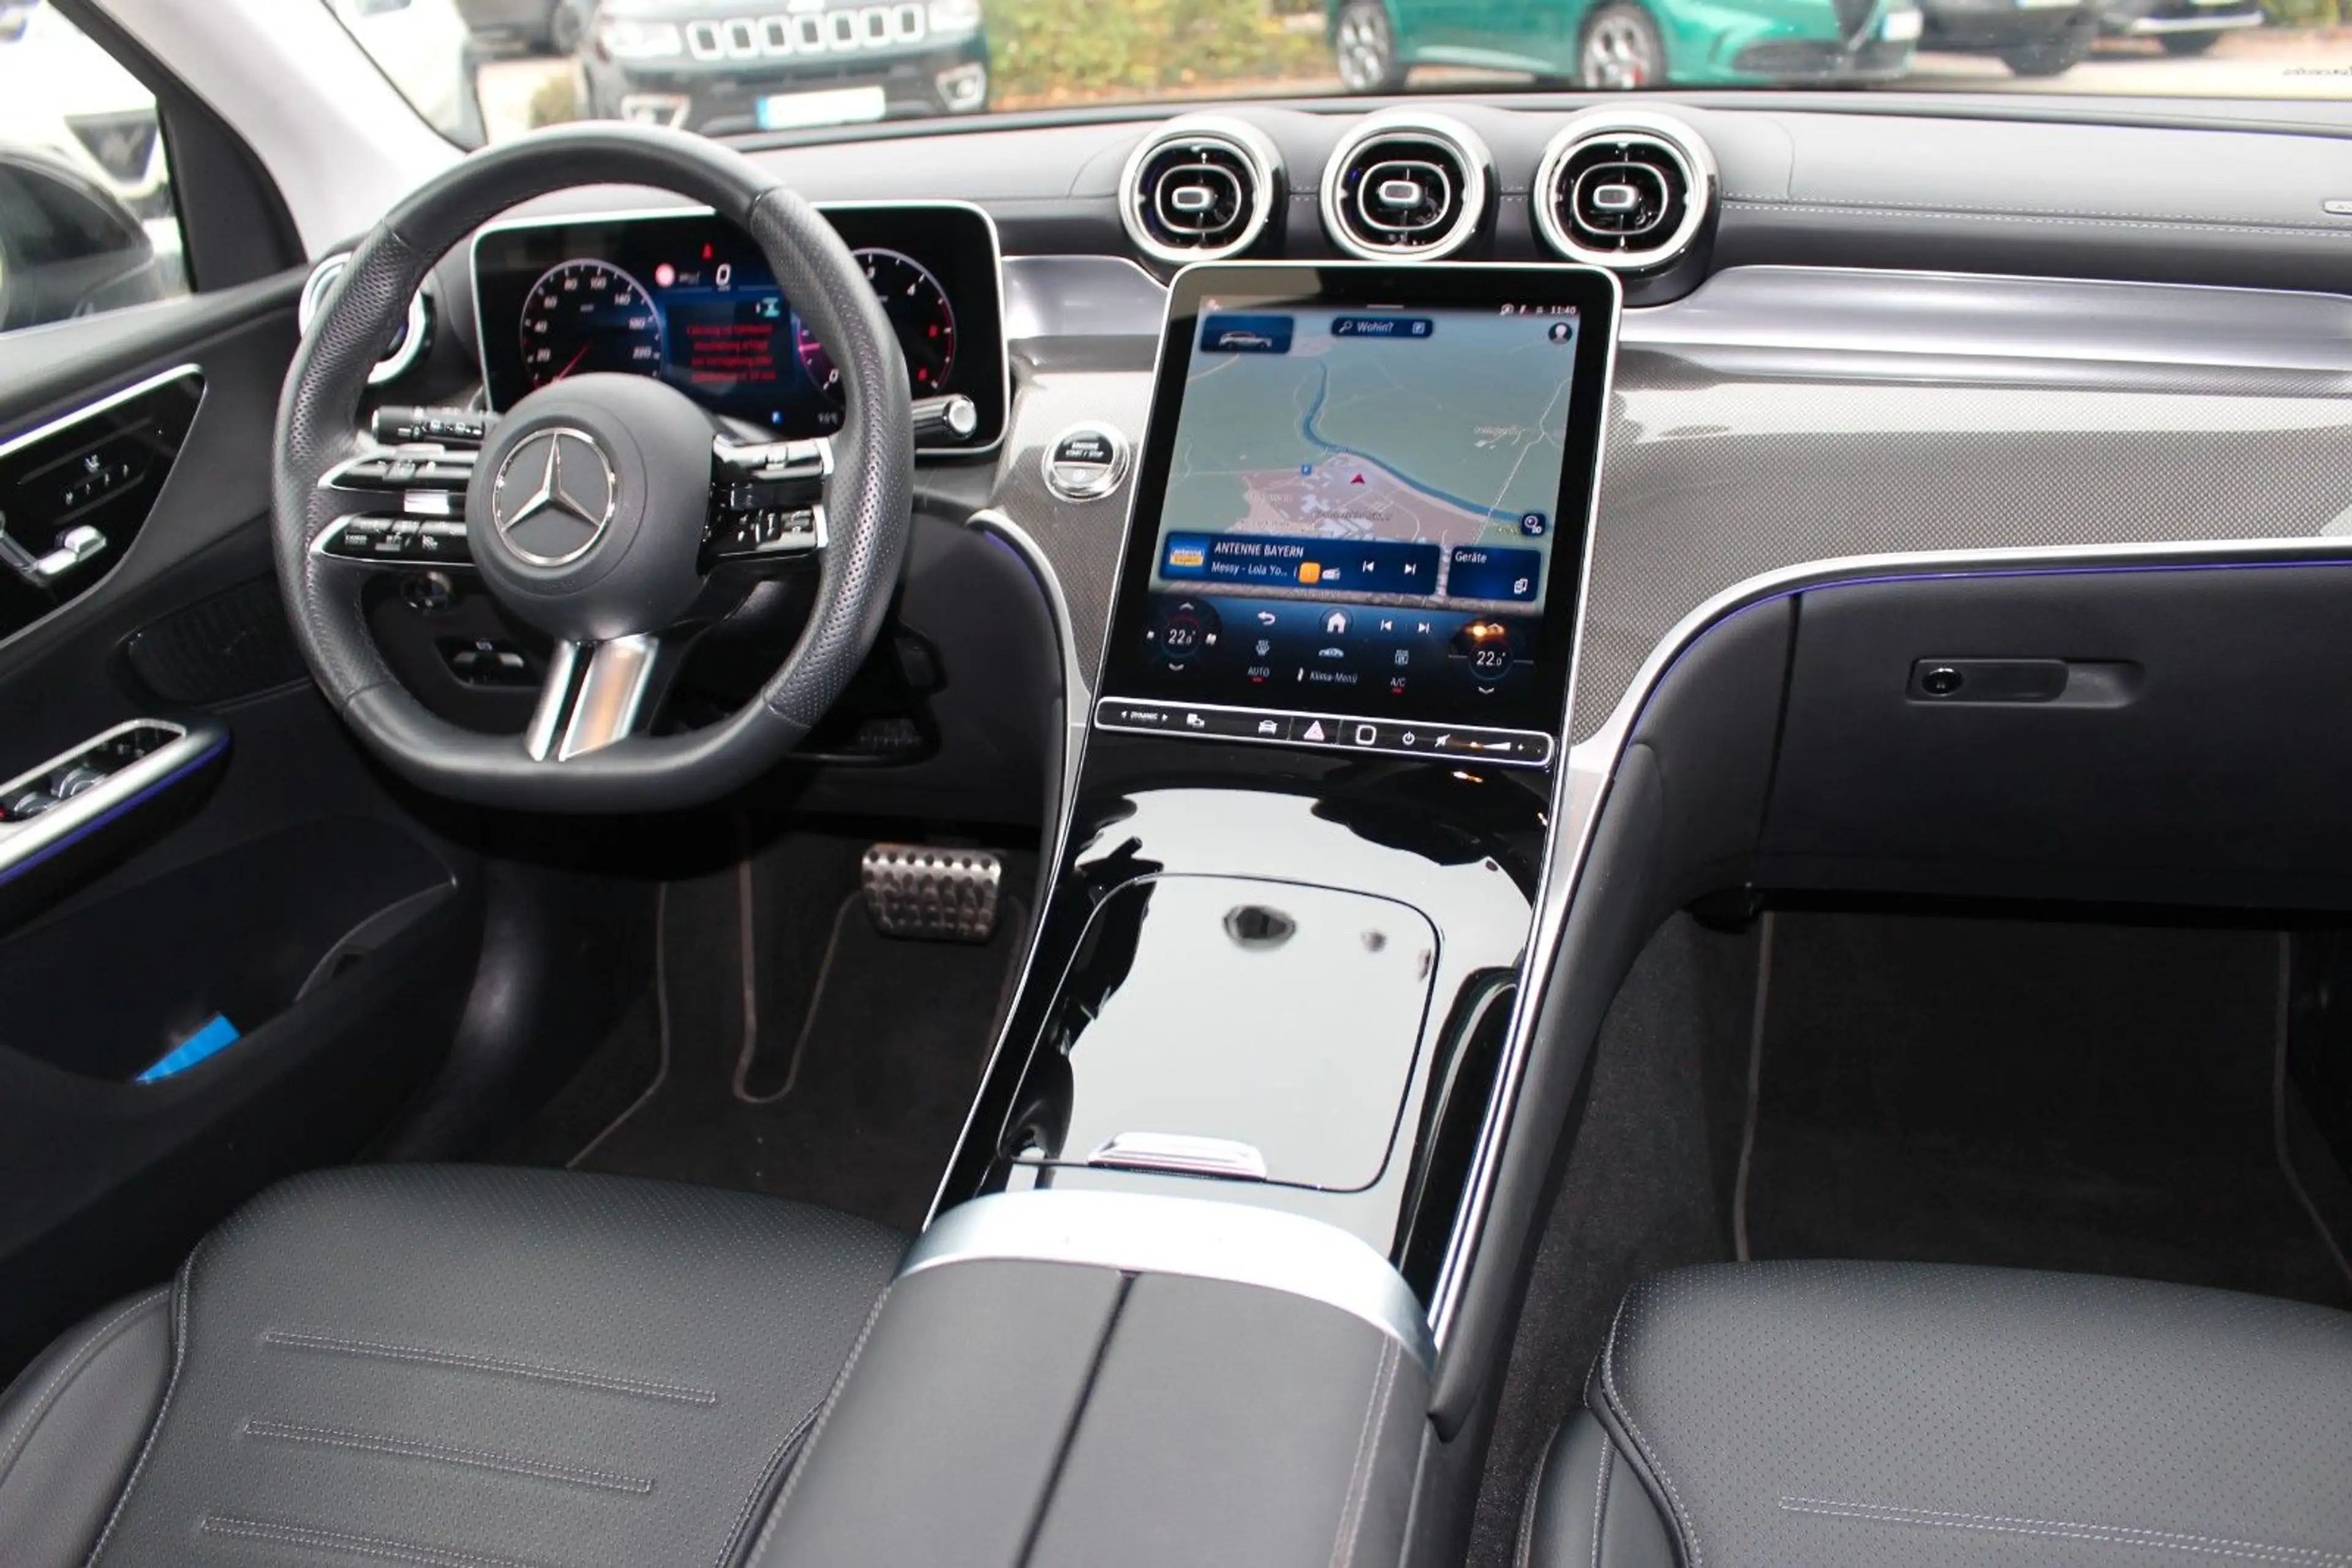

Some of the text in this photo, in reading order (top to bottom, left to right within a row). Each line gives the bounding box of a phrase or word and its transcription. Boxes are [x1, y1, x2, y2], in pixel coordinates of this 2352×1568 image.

[715, 263, 732, 287] 0
[590, 276, 607, 290] 100
[614, 293, 631, 306] 140
[534, 320, 548, 334] 40
[1357, 321, 1395, 333] Wohin?
[536, 348, 551, 363] 20
[1214, 541, 1305, 559] ANTENNE BAYERN
[1455, 550, 1487, 564] Geräte
[1211, 561, 1240, 576] Messy
[1247, 564, 1267, 576] Lola
[1247, 666, 1270, 678] AUTO
[1310, 671, 1358, 684] Klima-Menü
[1390, 677, 1406, 687] A/C
